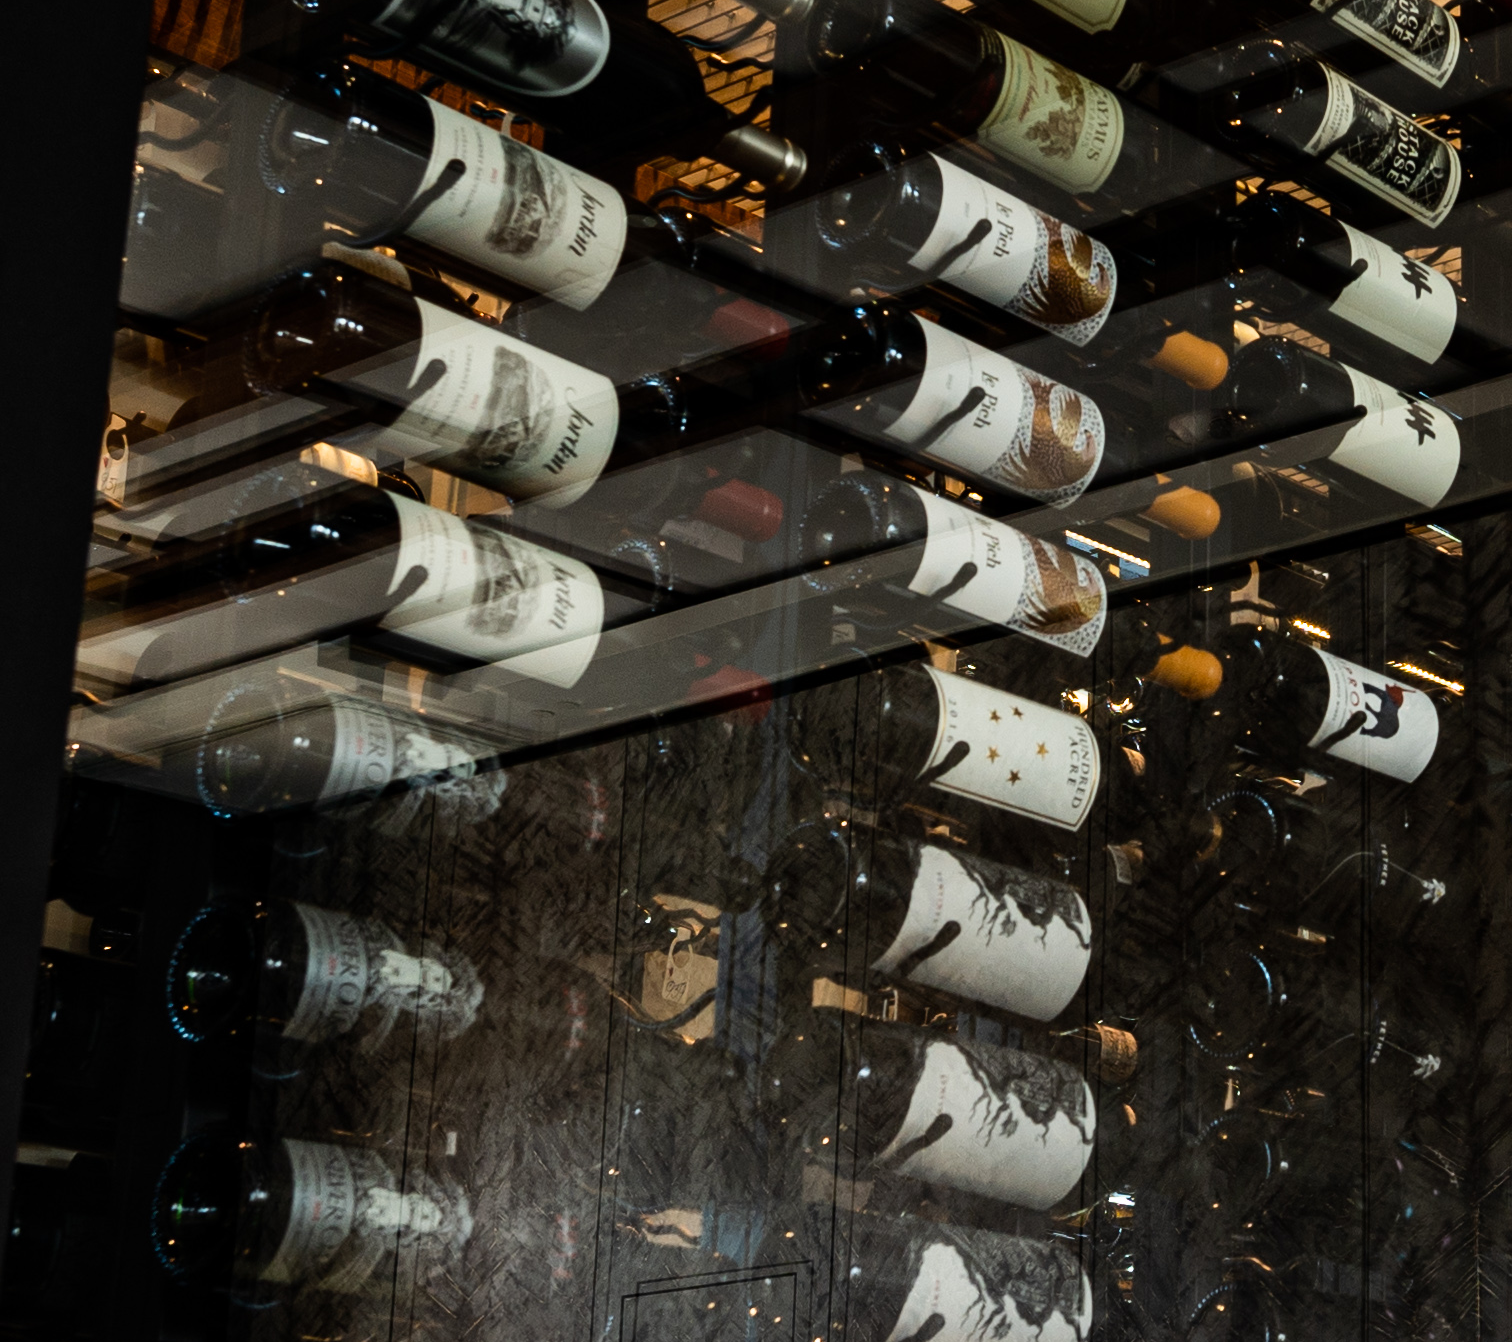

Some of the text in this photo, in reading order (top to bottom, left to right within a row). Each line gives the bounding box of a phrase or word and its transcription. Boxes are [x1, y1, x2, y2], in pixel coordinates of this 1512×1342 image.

[565, 172, 606, 257] Jordan
[993, 220, 1015, 260] Pich
[542, 386, 594, 475] Jordan
[972, 390, 999, 430] Pich
[985, 529, 1003, 570] Pich
[944, 696, 958, 744] 2016
[1066, 735, 1080, 787] ACRE
[1071, 724, 1092, 810] HUNDRED
